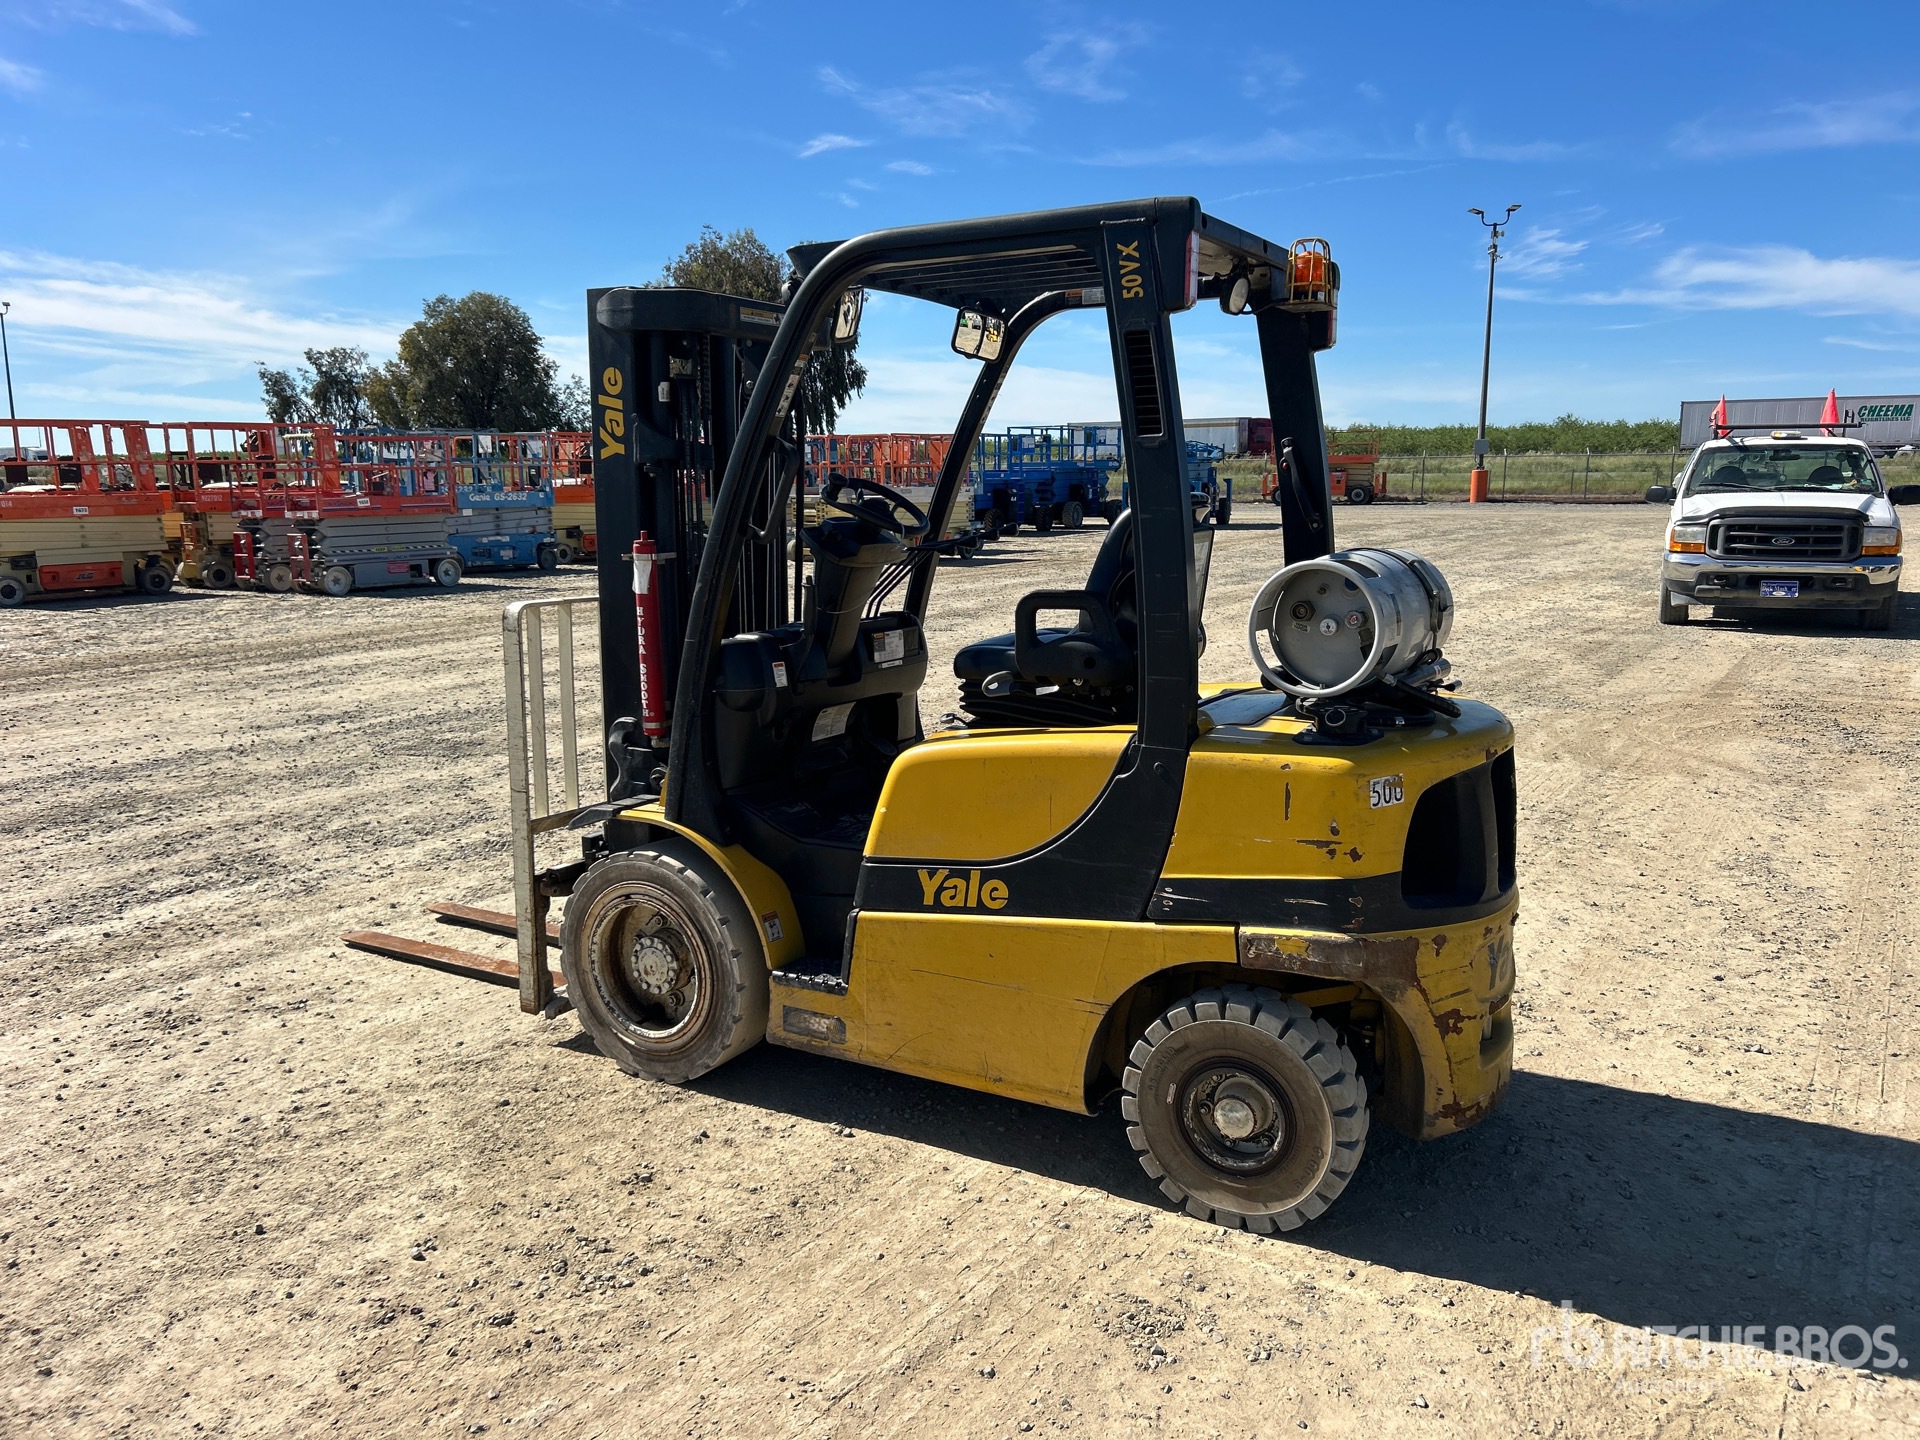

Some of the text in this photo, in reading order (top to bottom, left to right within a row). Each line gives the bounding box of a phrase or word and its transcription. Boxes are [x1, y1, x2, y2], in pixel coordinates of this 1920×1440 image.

[1116, 240, 1144, 299] 50VX
[598, 366, 625, 460] Yale
[1857, 404, 1915, 418] CHEEMA
[469, 493, 527, 501] Genie GS-2632
[636, 606, 650, 717] HYDRA SMOOTH
[917, 869, 1009, 910] Yale
